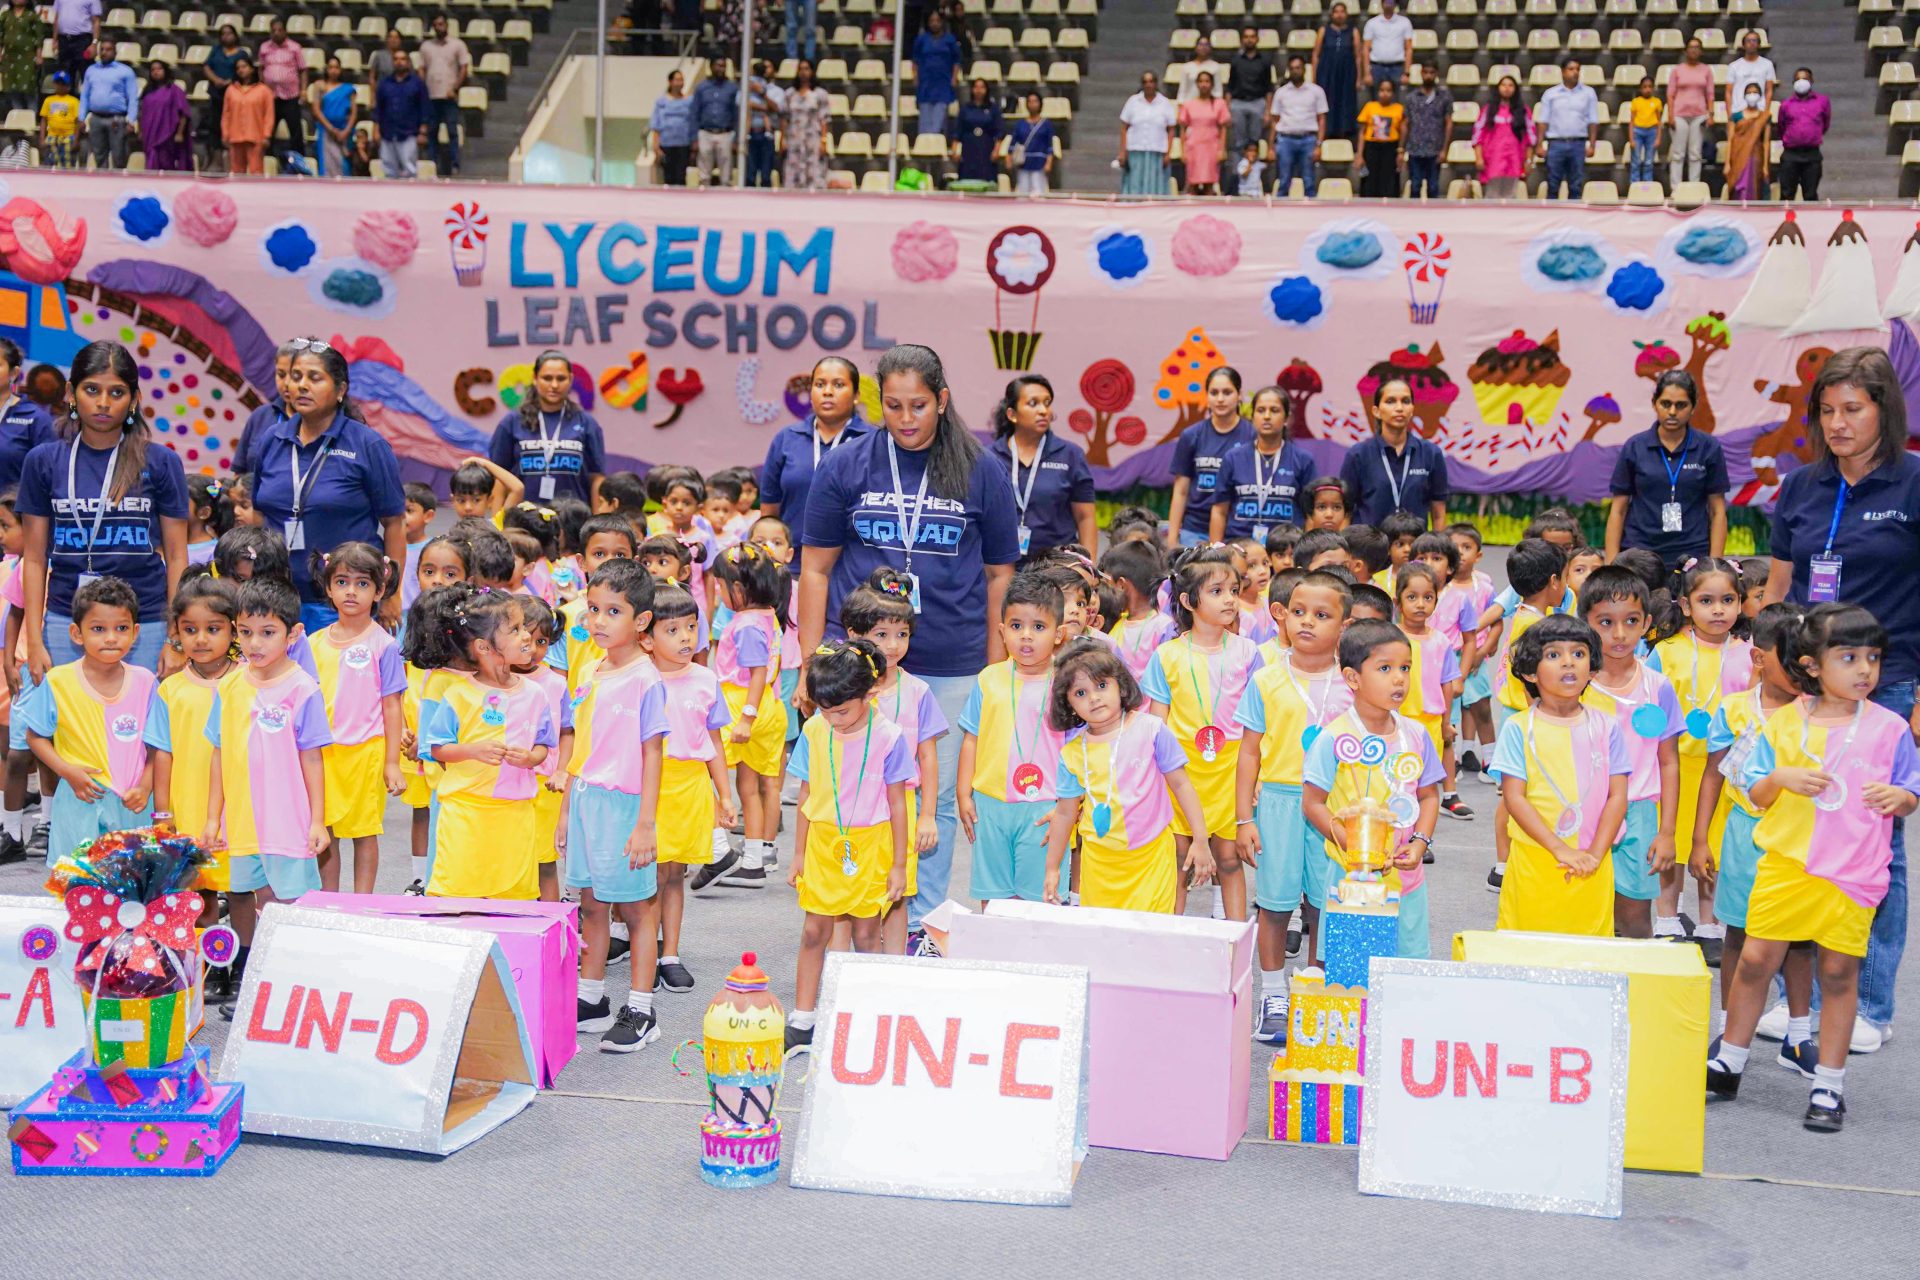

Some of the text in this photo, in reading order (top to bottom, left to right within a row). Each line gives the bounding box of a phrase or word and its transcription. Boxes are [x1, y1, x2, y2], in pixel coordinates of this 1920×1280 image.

[509, 222, 834, 297] LYCEUM
[486, 295, 897, 353] LEAF SCHOOL
[519, 439, 583, 452] TEAHER
[520, 456, 581, 470] SQUAD
[1235, 484, 1296, 497] TEAHER
[51, 497, 151, 513] TEACHER
[860, 491, 966, 514] TEACHER
[1236, 502, 1293, 517] SQUAD
[55, 526, 149, 549] SQUAD
[246, 981, 429, 1065] UN-D
[1292, 1009, 1359, 1048] UN
[831, 1011, 1060, 1100] UN-C
[1400, 1038, 1593, 1104] UN-B
